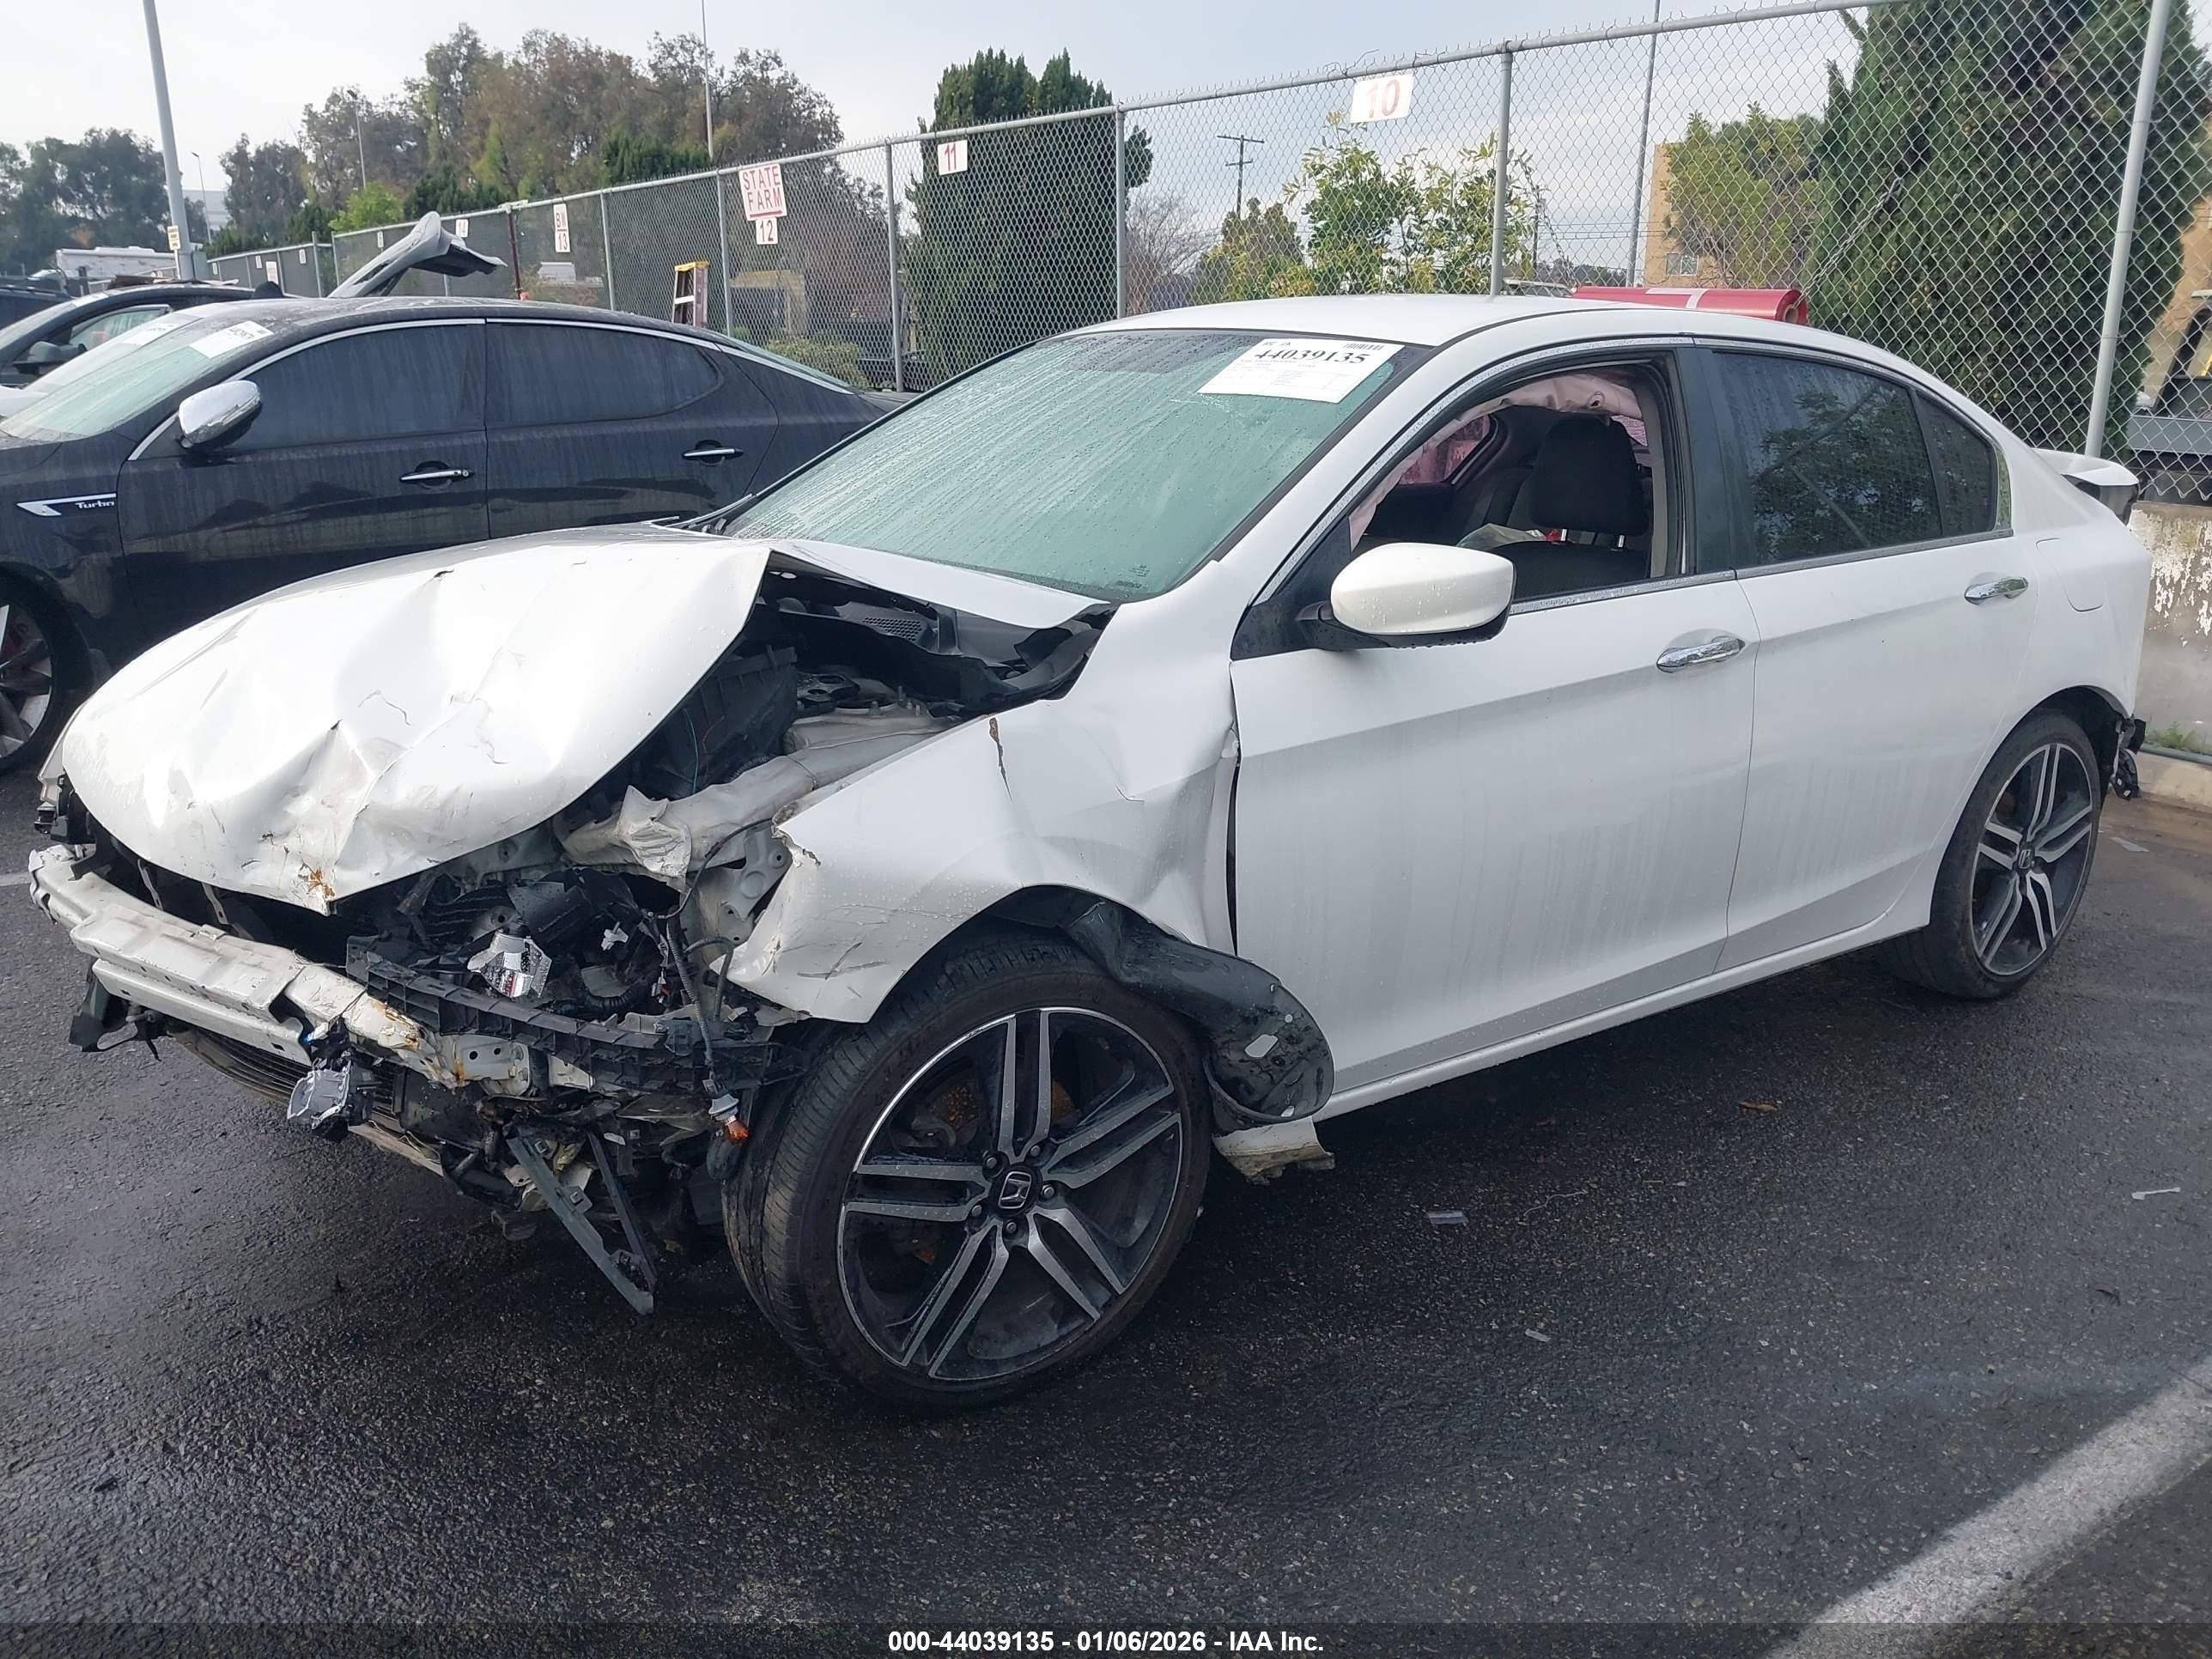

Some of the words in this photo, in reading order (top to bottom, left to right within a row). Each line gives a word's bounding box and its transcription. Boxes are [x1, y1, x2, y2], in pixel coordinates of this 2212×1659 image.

[1366, 79, 1401, 118] 10
[944, 143, 957, 172] 11
[742, 166, 781, 191] STATE
[747, 187, 782, 211] FARM
[558, 233, 568, 251] 13
[760, 219, 775, 242] 12
[1255, 349, 1371, 364] 44039135
[75, 500, 115, 509] Turbo
